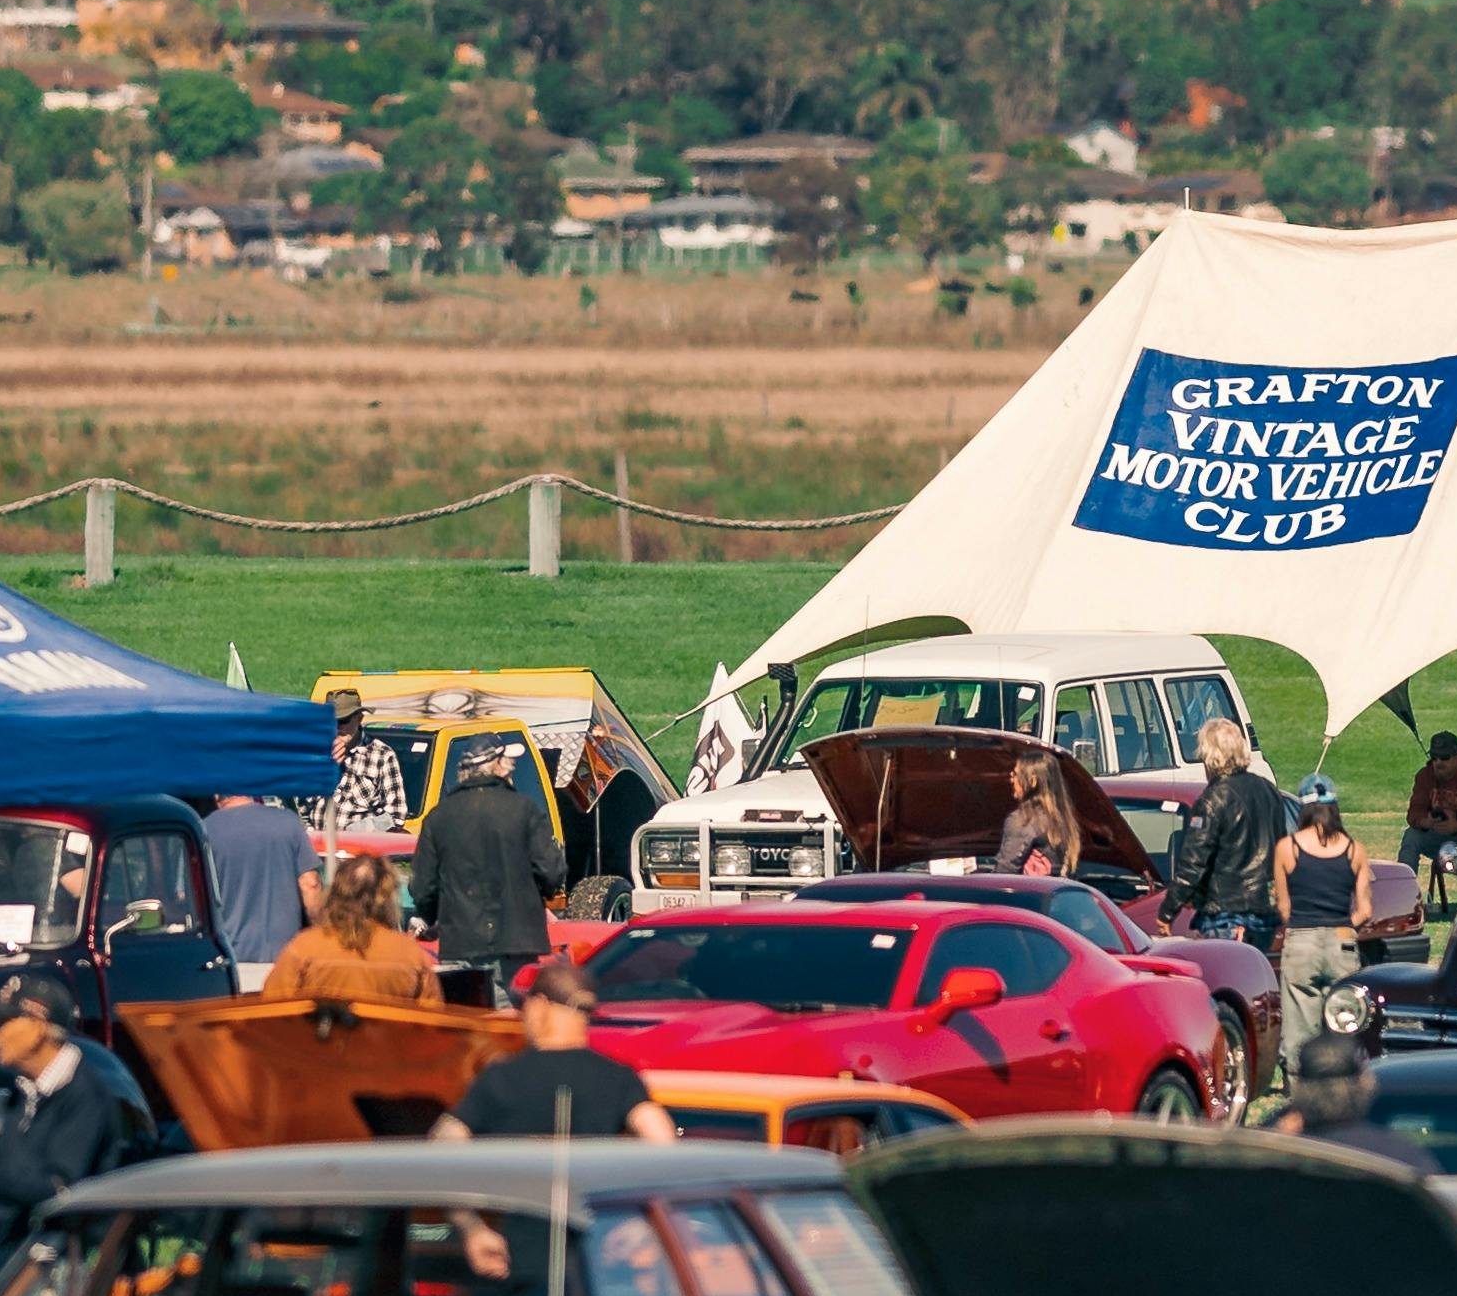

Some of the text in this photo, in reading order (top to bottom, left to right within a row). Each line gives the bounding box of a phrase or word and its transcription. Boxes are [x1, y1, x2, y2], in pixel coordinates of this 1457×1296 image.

[1172, 373, 1444, 410] GRAFTON
[1167, 409, 1420, 459] VINTAGE
[1100, 442, 1444, 502] MOTOR VEHICLE
[1183, 499, 1347, 546] CLUB
[748, 847, 791, 862] TOYO
